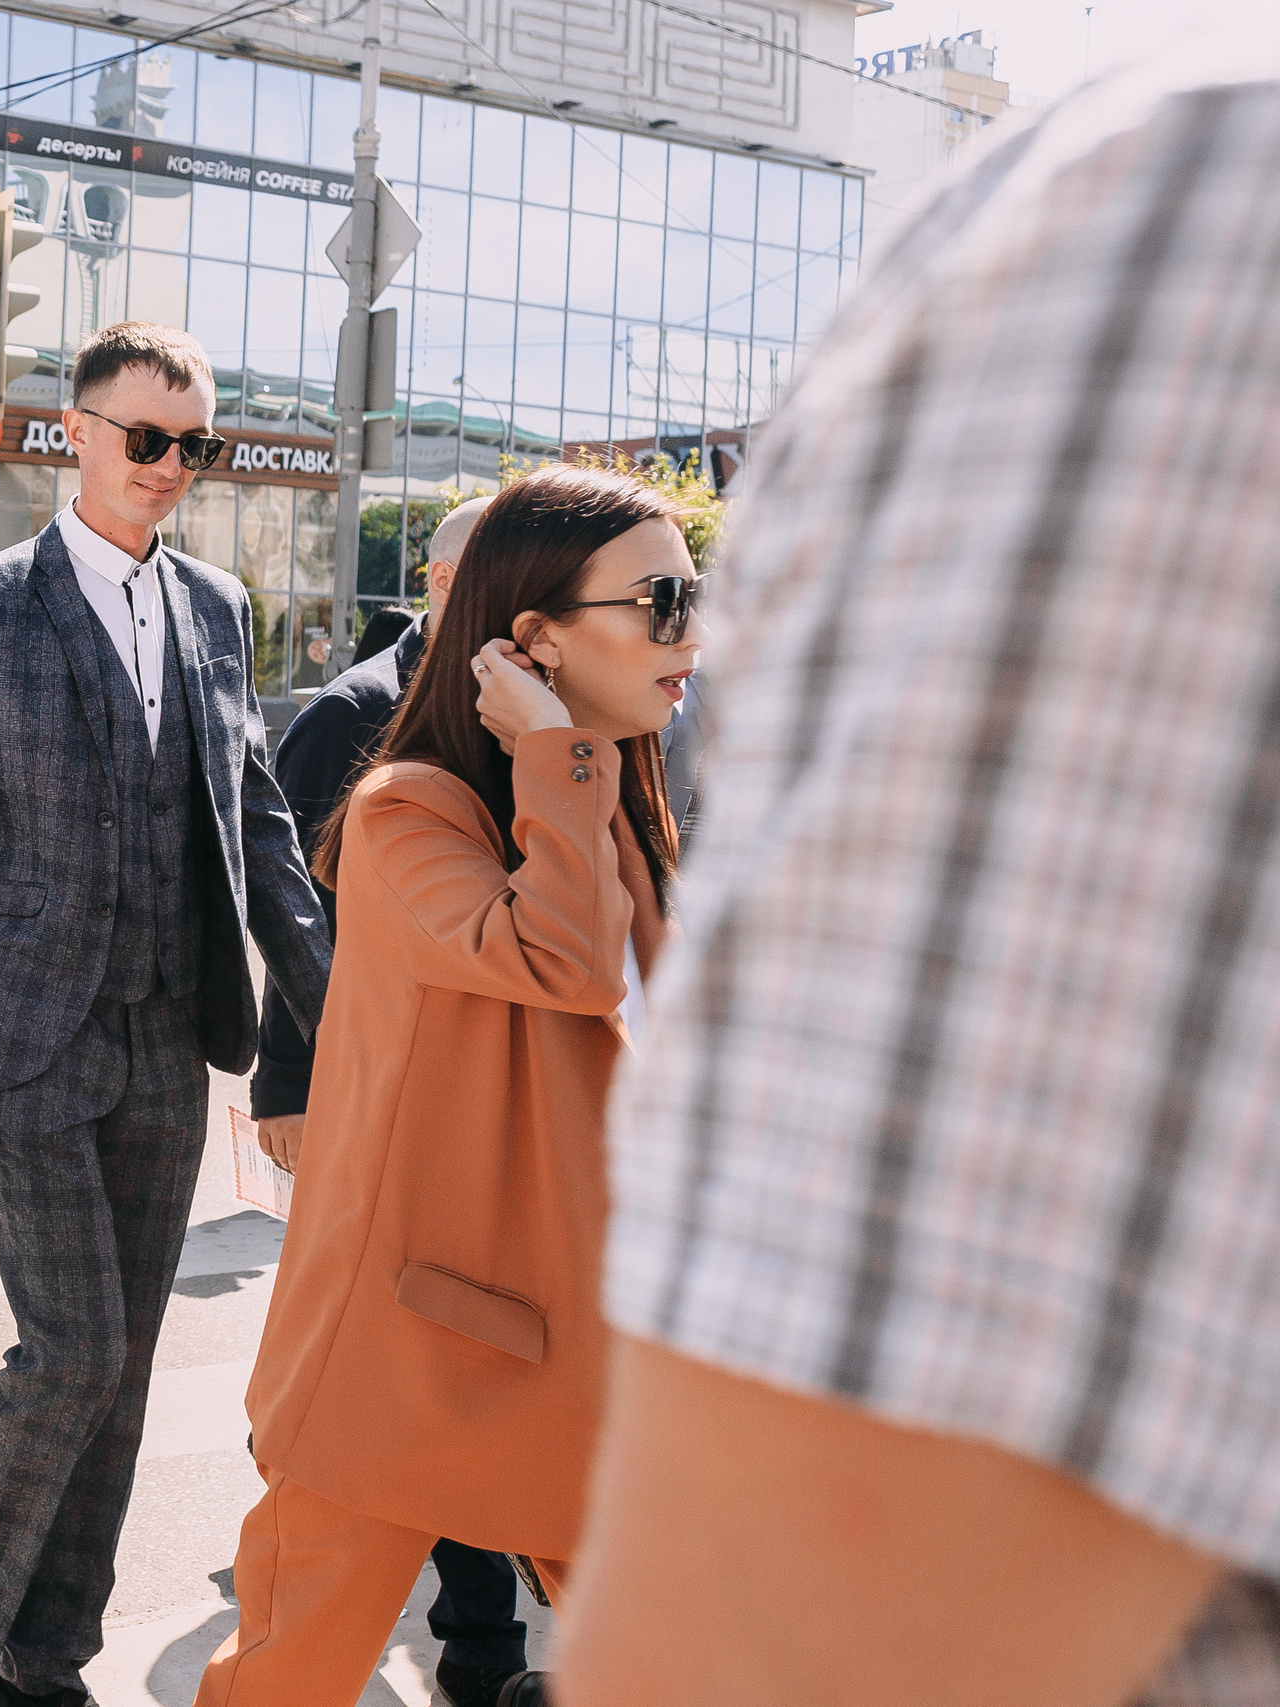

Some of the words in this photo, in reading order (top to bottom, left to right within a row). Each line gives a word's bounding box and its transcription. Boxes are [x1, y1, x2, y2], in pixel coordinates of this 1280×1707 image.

[37, 136, 122, 163] десерты
[166, 155, 251, 184] КОФЕЙНЯ
[255, 169, 323, 197] COFFEE
[326, 181, 356, 202] STA
[22, 420, 74, 457] ДО
[231, 442, 334, 475] ДОСТАВК
